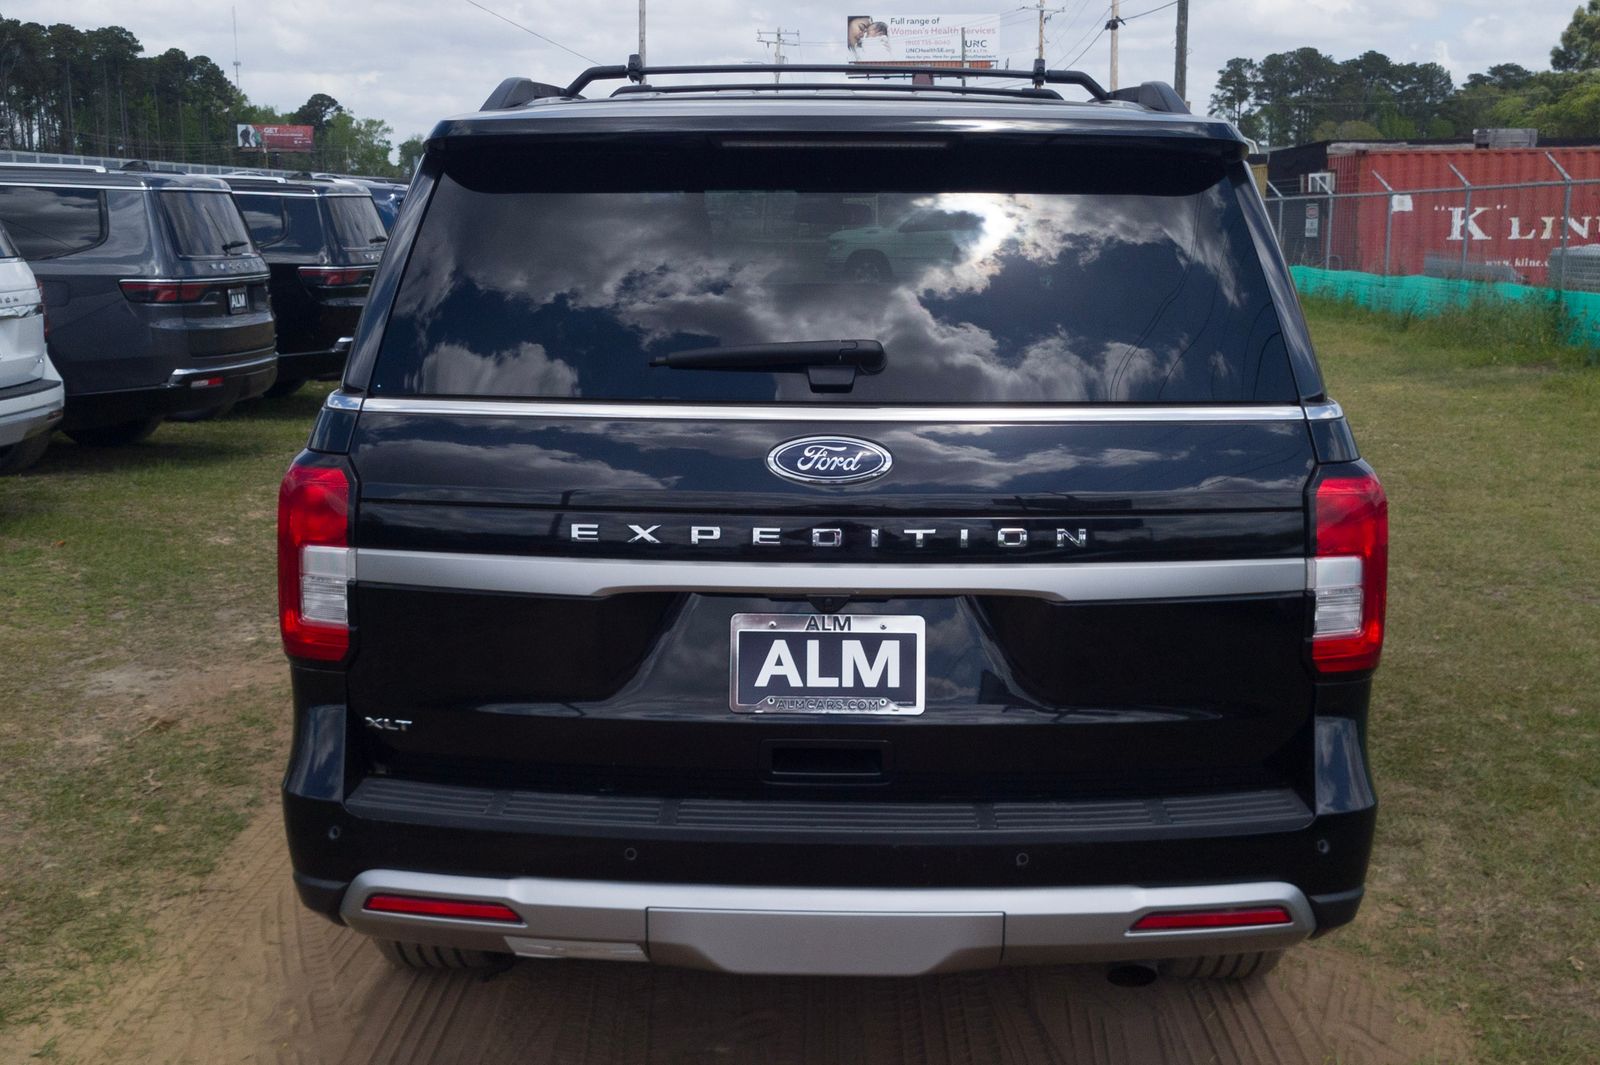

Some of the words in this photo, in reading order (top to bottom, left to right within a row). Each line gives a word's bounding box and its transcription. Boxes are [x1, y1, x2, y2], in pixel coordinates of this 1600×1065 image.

[890, 17, 905, 25] Full
[906, 19, 930, 27] range
[931, 17, 940, 25] of
[931, 27, 959, 35] Health
[965, 39, 987, 48] UNC
[1508, 216, 1600, 241] LIN
[231, 294, 246, 308] ALM
[797, 445, 861, 471] Ford
[571, 523, 1087, 547] EXPEDITION
[805, 615, 852, 632] ALM
[754, 639, 900, 688] ALM
[776, 698, 880, 711] ALMCARS.COM
[364, 716, 413, 731] XLT
